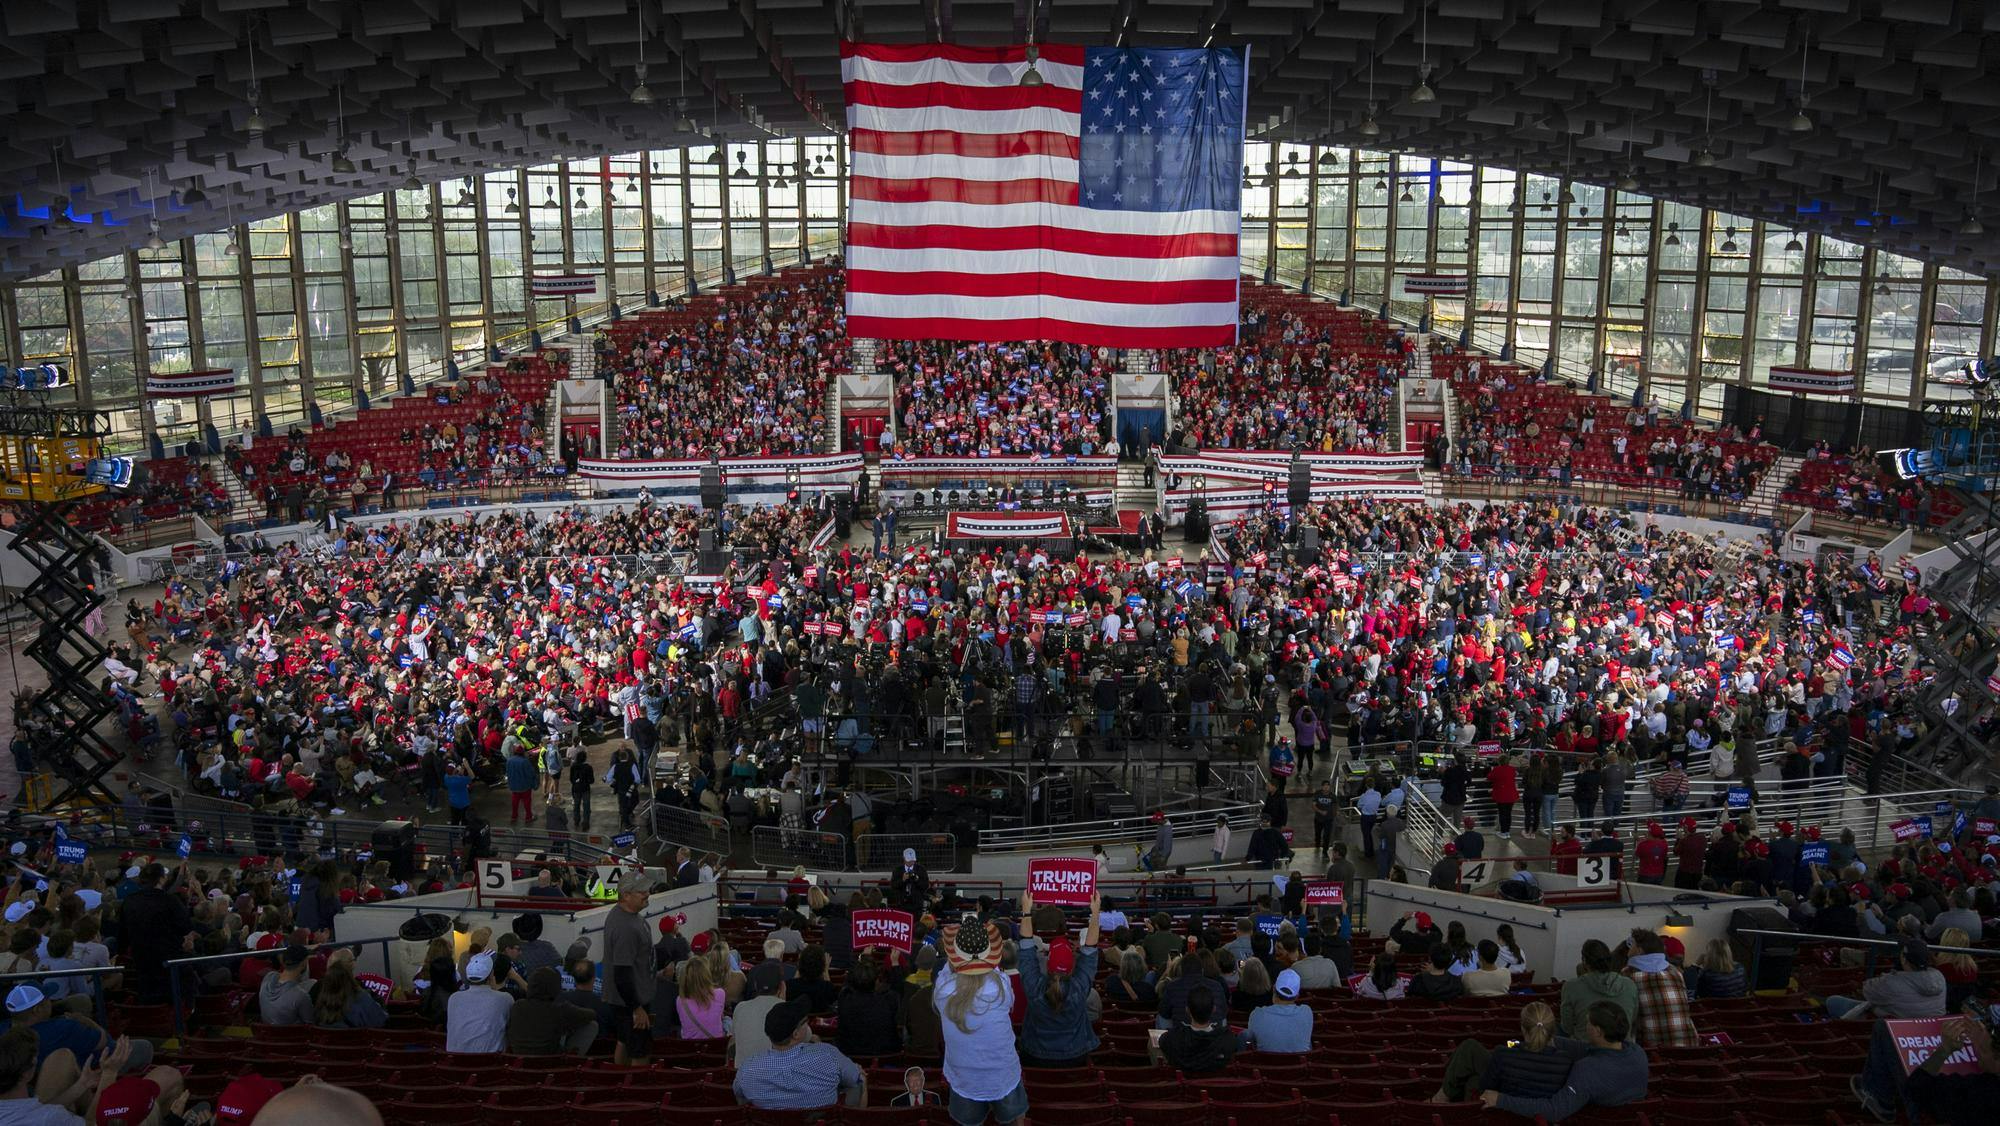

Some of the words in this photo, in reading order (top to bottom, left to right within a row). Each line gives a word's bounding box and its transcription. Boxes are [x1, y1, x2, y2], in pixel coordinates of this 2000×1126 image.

[58, 846, 85, 854] TRUMP
[486, 863, 504, 889] 5
[1032, 870, 1093, 884] TRUMP
[1461, 863, 1486, 883] 4
[1585, 858, 1604, 884] 3
[1032, 883, 1058, 892] WILL
[1061, 884, 1078, 892] FIX
[1080, 885, 1092, 893] IT
[856, 919, 910, 933] TRUMP
[857, 930, 881, 938] WILL
[883, 930, 898, 939] FIX
[900, 933, 909, 942] IT
[1898, 1036, 1942, 1048] DREAM
[1907, 1046, 1977, 1066] AGIN!
[103, 1107, 129, 1116] TRUMP
[220, 1105, 243, 1116] TRUMP
